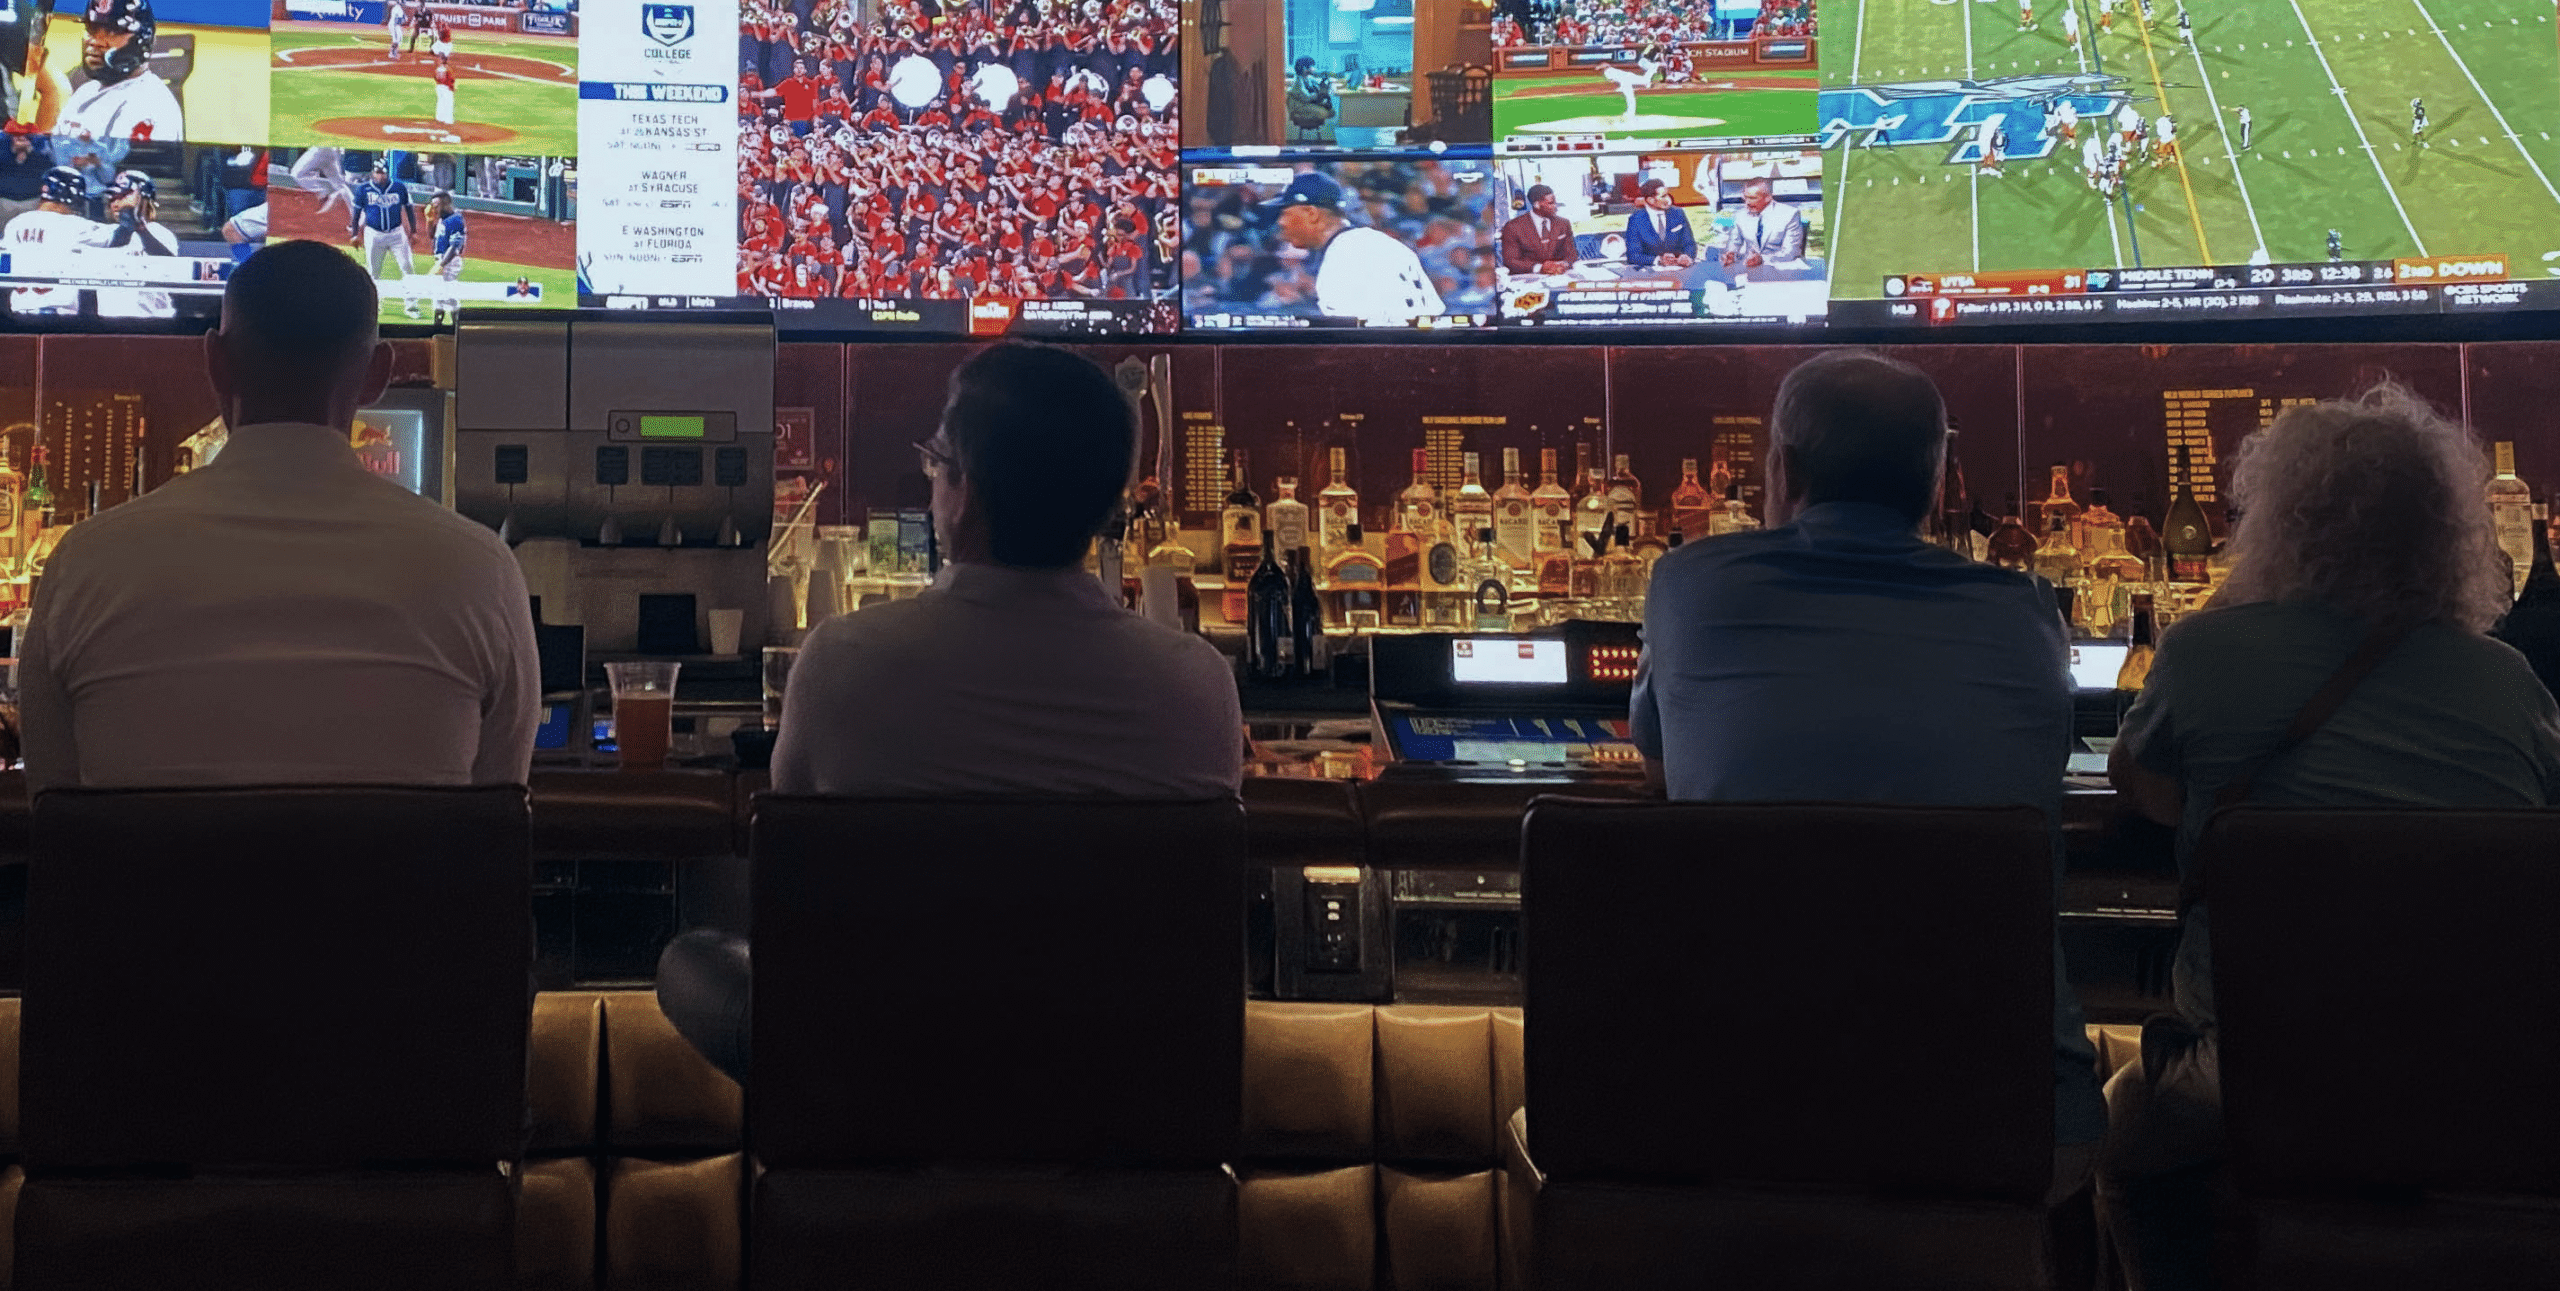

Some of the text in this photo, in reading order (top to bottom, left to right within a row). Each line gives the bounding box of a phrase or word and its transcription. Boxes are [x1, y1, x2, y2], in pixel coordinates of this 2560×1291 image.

[433, 13, 508, 27] TRUIST PARK
[644, 48, 692, 59] COLLEGE
[1704, 48, 1750, 57] STADIUM
[613, 84, 723, 103] THIS WEEKEND
[632, 114, 698, 125] TEXAS TECH
[645, 127, 691, 138] KANSAS
[641, 170, 687, 181] WAGNER
[641, 183, 699, 194] SYRACUSE
[622, 225, 705, 237] E WASHINGTON
[647, 239, 693, 250] FLORIDA
[2118, 268, 2215, 283] MIDDLE TENN
[2250, 268, 2275, 283] 20
[2280, 267, 2314, 282] 3RD
[2398, 261, 2504, 279] 2ND DOWN
[2063, 274, 2081, 289] 31
[2480, 282, 2529, 295] SPORTS
[2454, 293, 2520, 305] NETWORK
